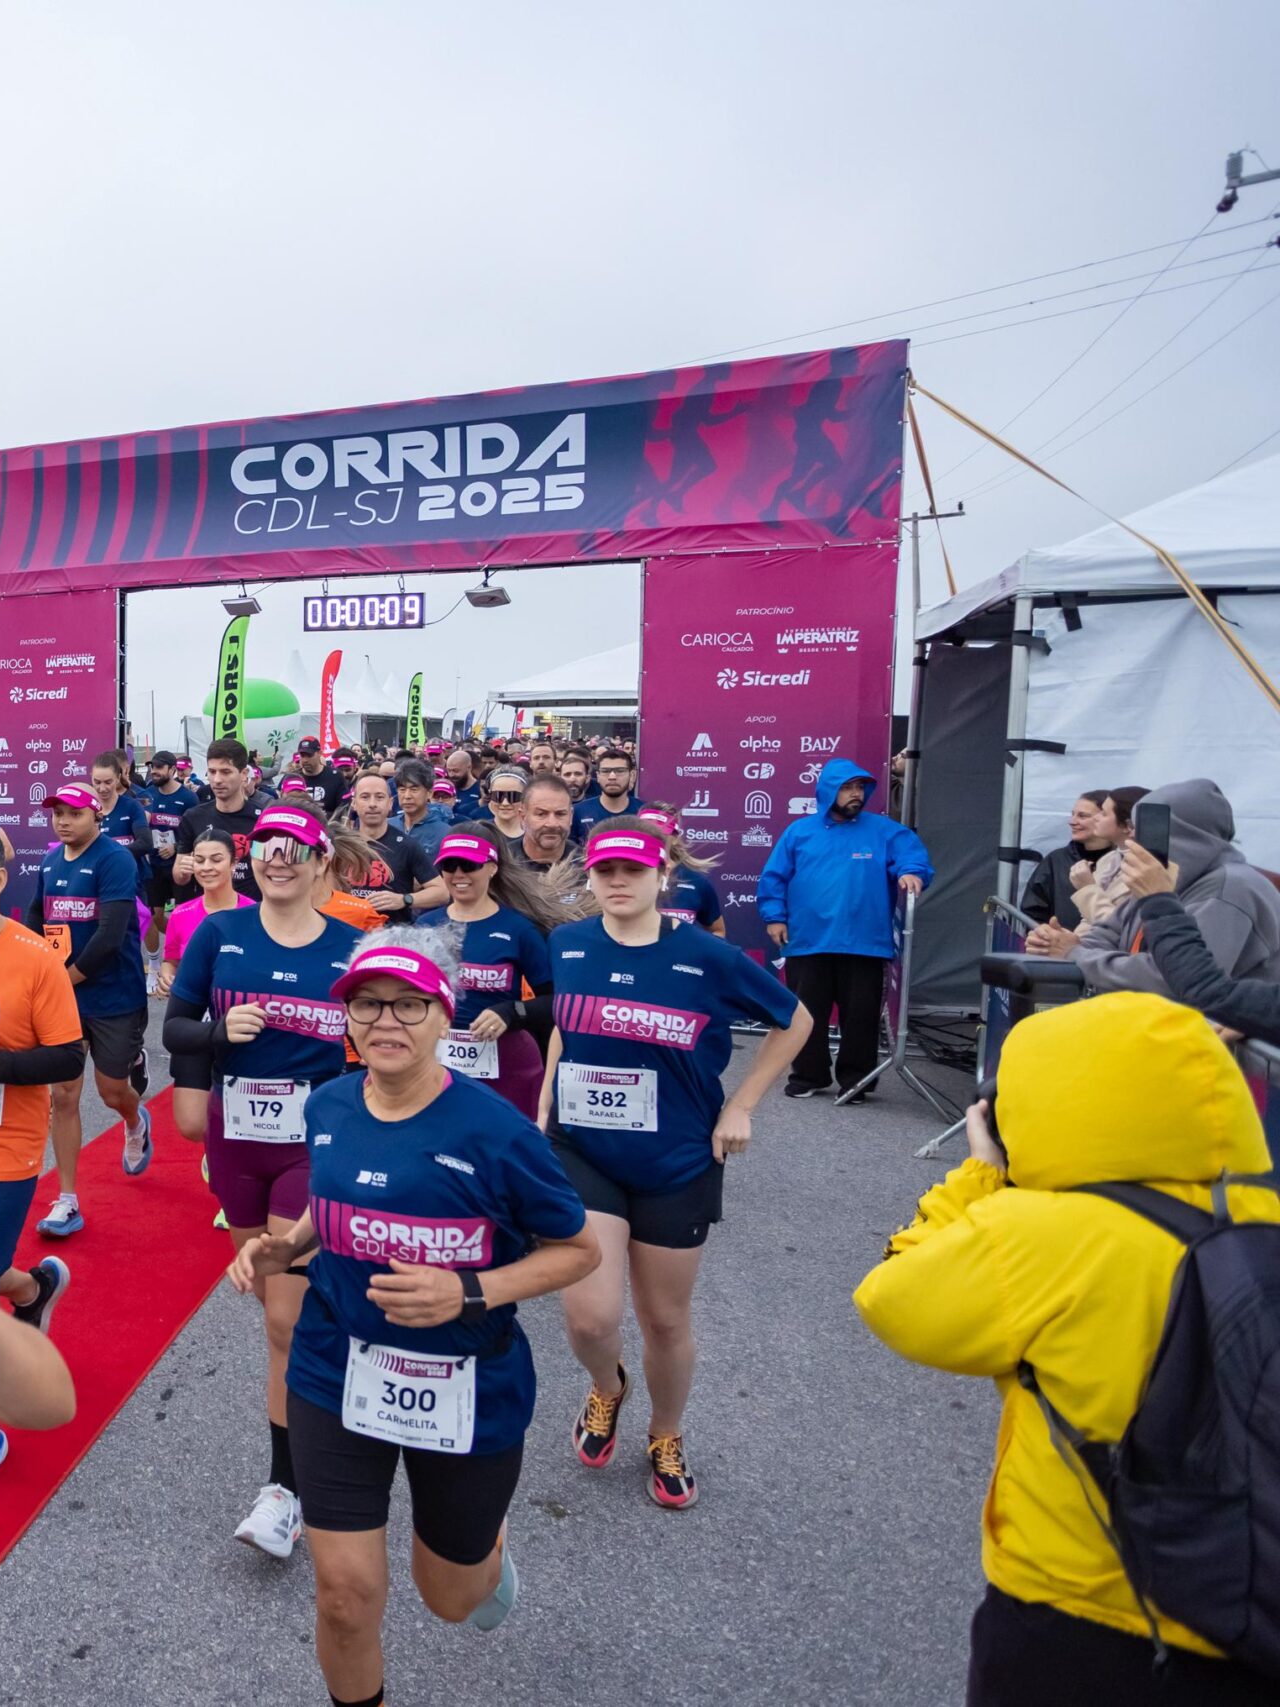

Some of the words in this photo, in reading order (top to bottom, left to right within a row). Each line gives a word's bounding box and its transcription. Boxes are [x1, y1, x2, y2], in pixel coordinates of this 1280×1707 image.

[230, 412, 585, 495] CORRIDA
[234, 487, 404, 534] CDL-SJ
[418, 472, 585, 521] 2025
[736, 606, 794, 616] PATROCÍNIO
[681, 632, 753, 647] CARIOCA
[776, 630, 860, 645] IMPERATRIZ
[45, 656, 95, 668] IMPERATRIZ
[742, 669, 811, 686] Sicredi
[26, 687, 68, 701] Sicredi
[25, 739, 51, 753] alpha
[62, 738, 87, 752] BALY
[739, 735, 781, 752] alpha
[799, 736, 841, 753] BALY
[686, 829, 728, 841] Select
[742, 835, 772, 843] SUNSET
[53, 900, 95, 911] CORRIDA
[477, 980, 506, 988] 2025
[621, 973, 634, 981] CDL
[265, 1015, 316, 1031] CDL-SJ
[601, 1004, 697, 1033] CORRIDA
[601, 1019, 654, 1038] CDL-SJ
[448, 1044, 478, 1059] 208
[586, 1089, 627, 1107] 382
[248, 1100, 283, 1118] 179
[589, 1109, 625, 1118] RAFAELA
[372, 1172, 388, 1182] CDL
[350, 1216, 485, 1249] CORRIDA
[352, 1237, 420, 1262] CDL-SJ
[425, 1245, 483, 1263] 2025
[381, 1380, 436, 1412] 300
[377, 1410, 438, 1431] CARMELITA
